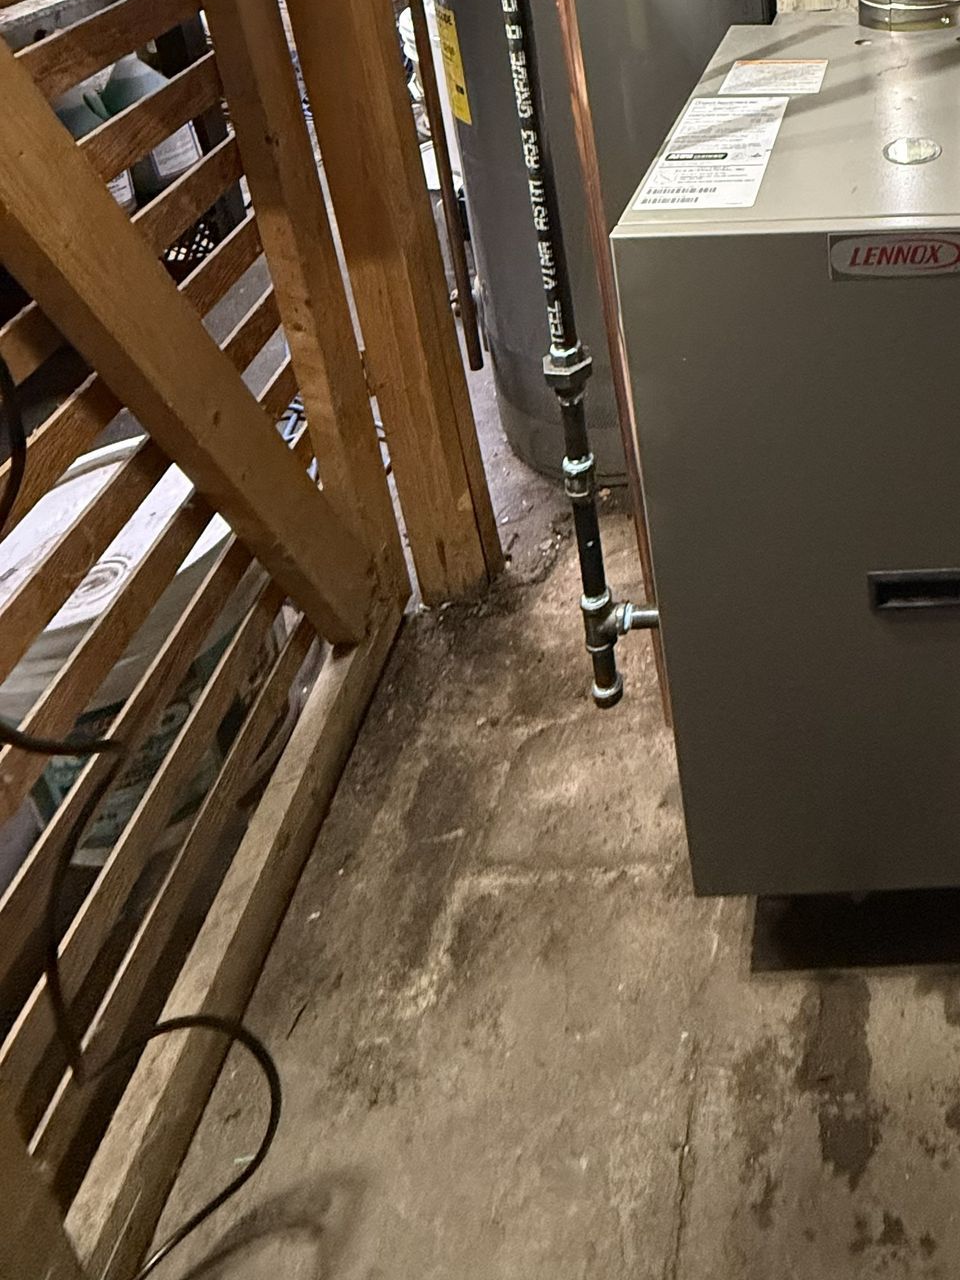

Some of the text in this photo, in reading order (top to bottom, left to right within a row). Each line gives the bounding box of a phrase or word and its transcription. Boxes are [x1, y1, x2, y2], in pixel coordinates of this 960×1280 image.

[519, 128, 539, 168] A53
[849, 245, 944, 267] LENNOX
[544, 300, 563, 343] TEEL
